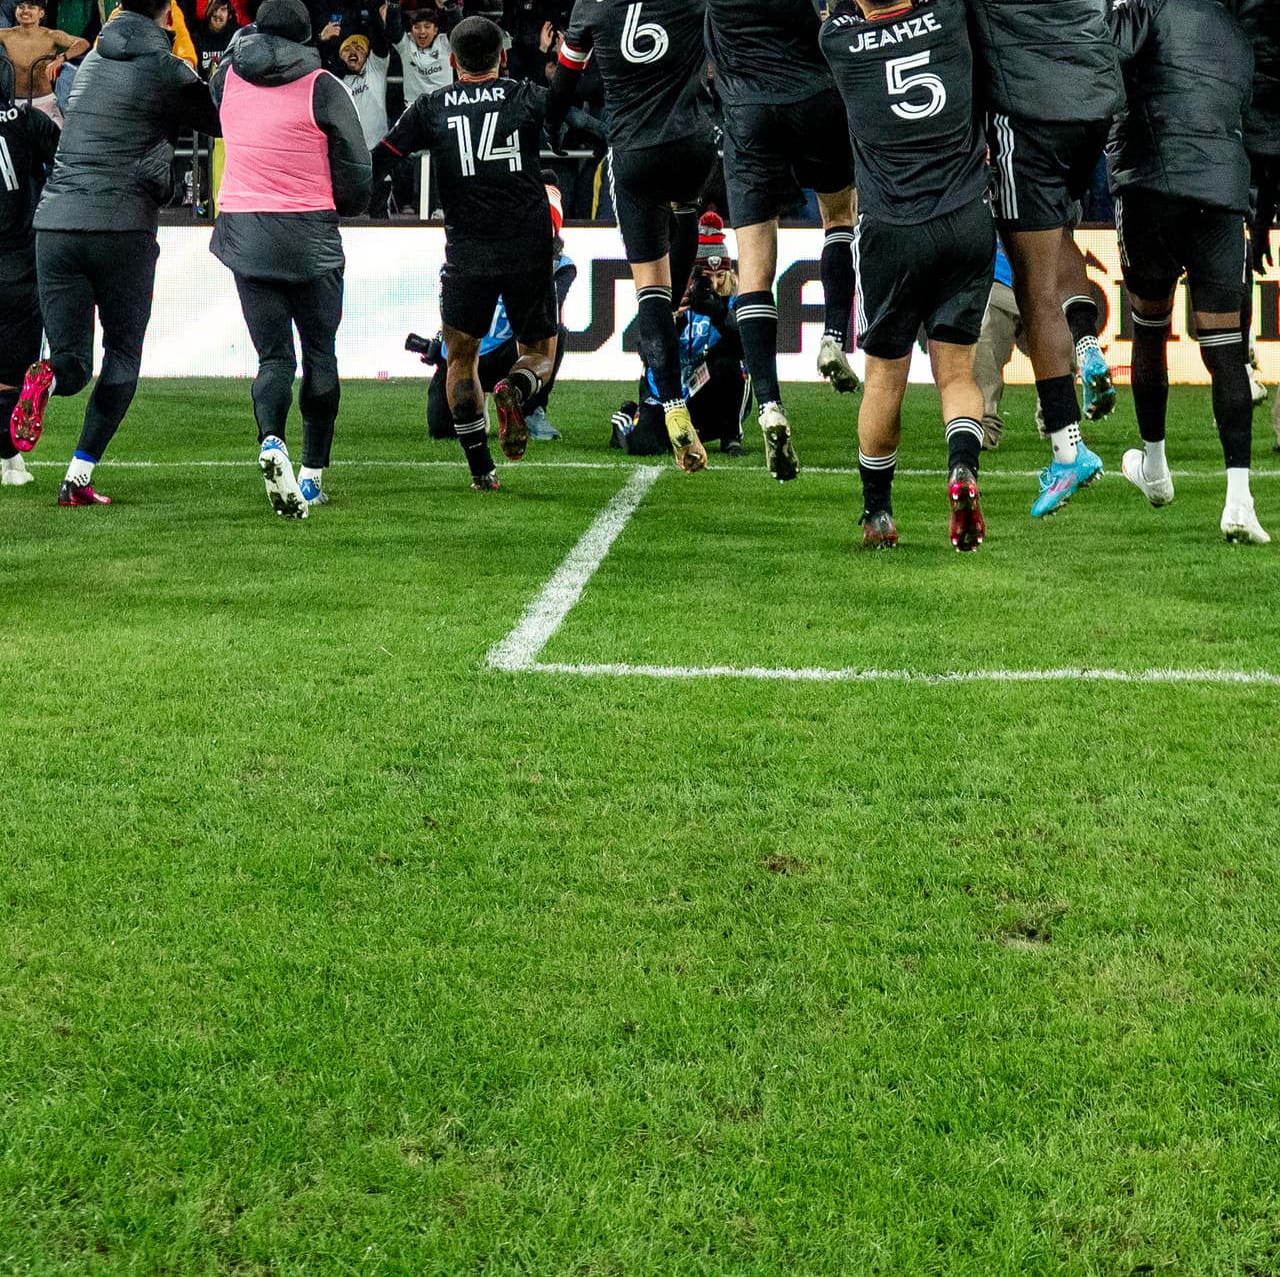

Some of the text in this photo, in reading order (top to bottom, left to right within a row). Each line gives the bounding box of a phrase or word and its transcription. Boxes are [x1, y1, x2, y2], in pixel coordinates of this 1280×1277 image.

[620, 2, 670, 65] 6
[848, 12, 942, 54] JEAHZE
[444, 86, 506, 108] NAJAR
[884, 50, 947, 120] 5
[447, 111, 522, 177] 14
